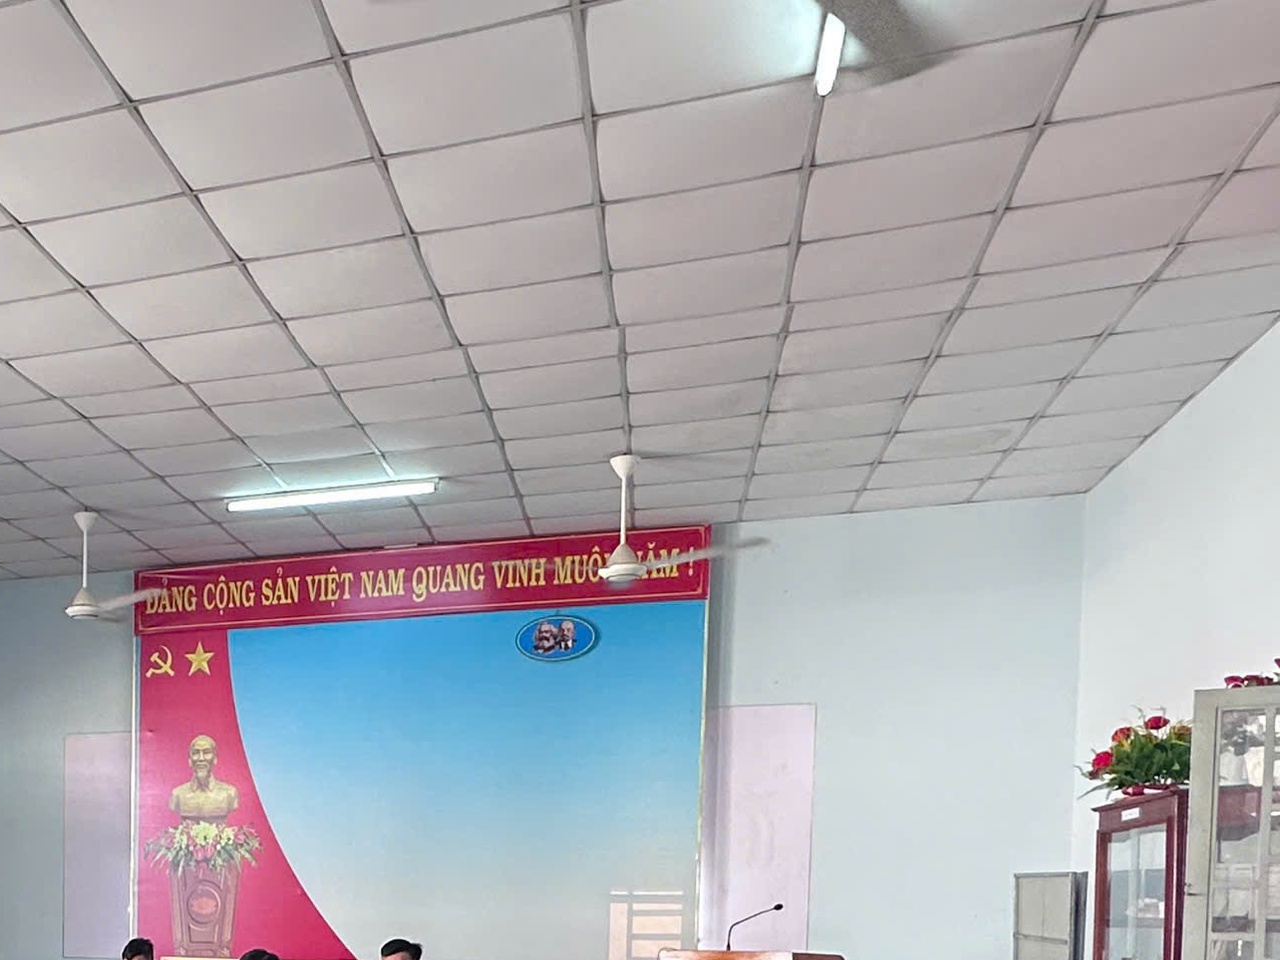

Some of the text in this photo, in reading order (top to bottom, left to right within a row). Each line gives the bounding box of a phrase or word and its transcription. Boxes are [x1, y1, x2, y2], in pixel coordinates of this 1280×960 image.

[203, 575, 256, 615] CỘNG
[261, 566, 300, 606] SẢN
[306, 565, 354, 607] VIỆT
[360, 568, 406, 599] NAM
[412, 561, 486, 602] QUANG
[492, 557, 548, 589] VINH
[553, 545, 610, 586] MUÔ
